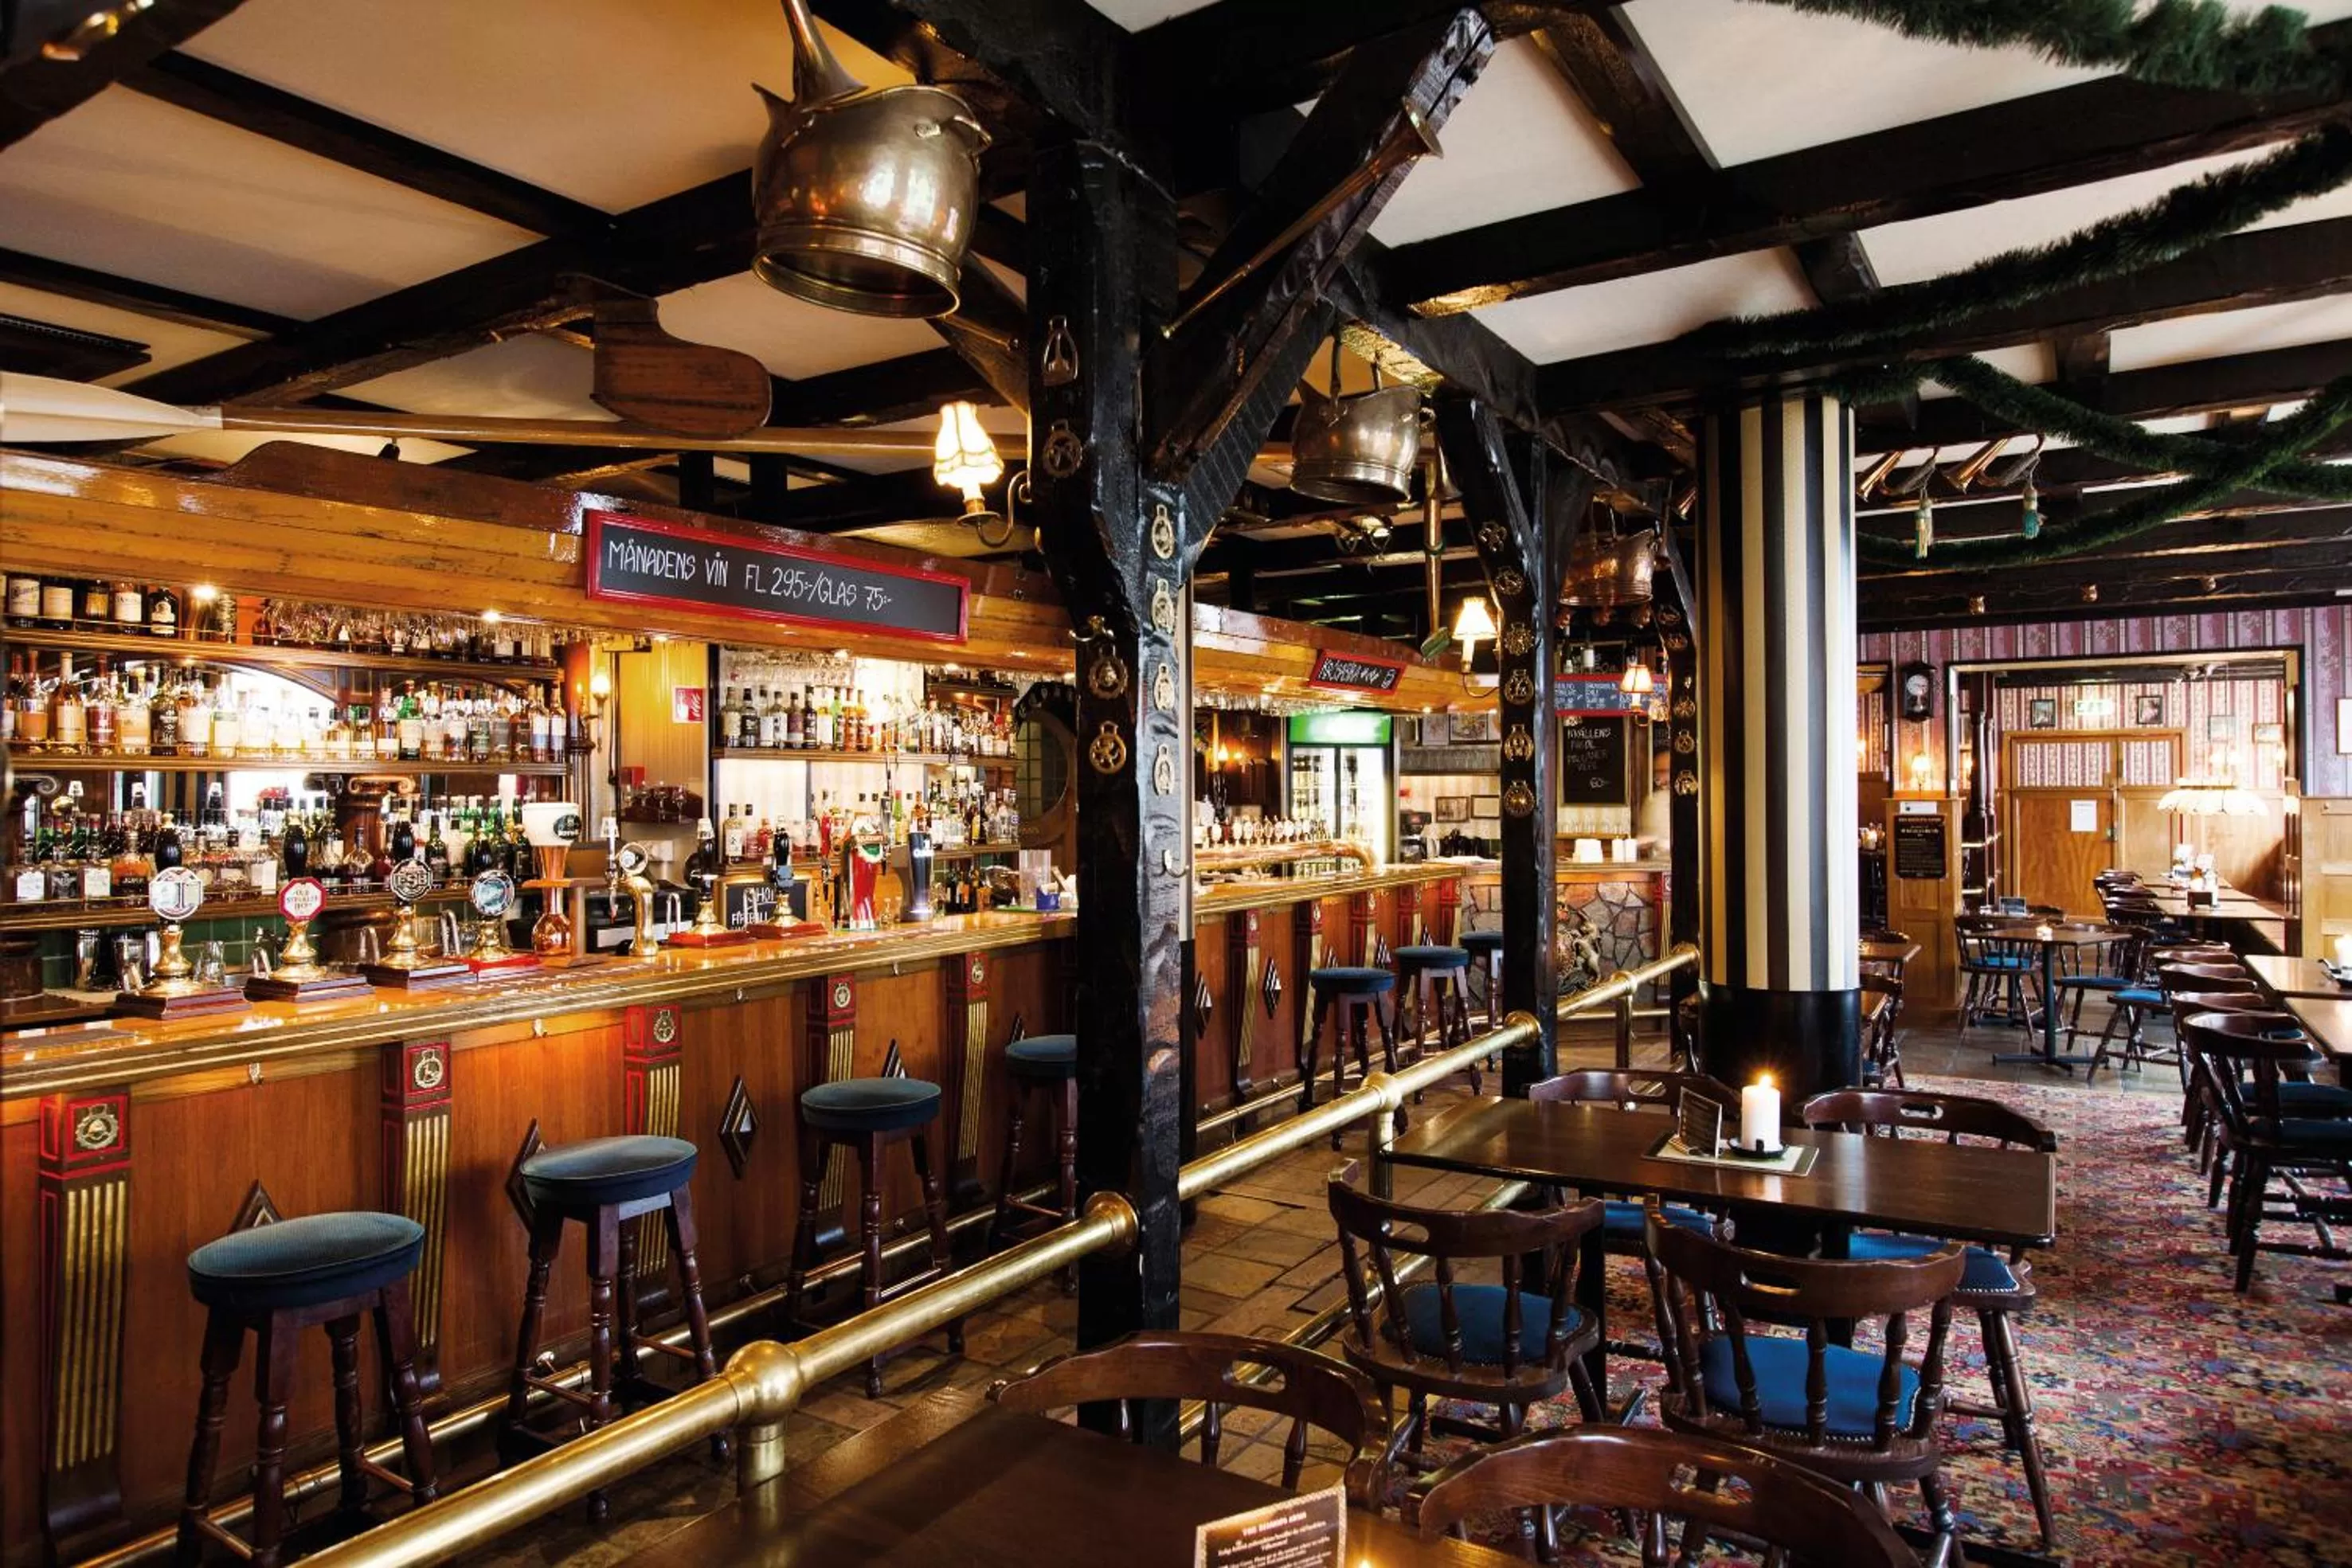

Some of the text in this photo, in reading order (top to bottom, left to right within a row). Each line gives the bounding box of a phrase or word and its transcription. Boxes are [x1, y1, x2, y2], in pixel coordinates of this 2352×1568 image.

[608, 538, 696, 581] MÅNADENS
[744, 564, 767, 593] FL
[863, 585, 892, 611] 75:-
